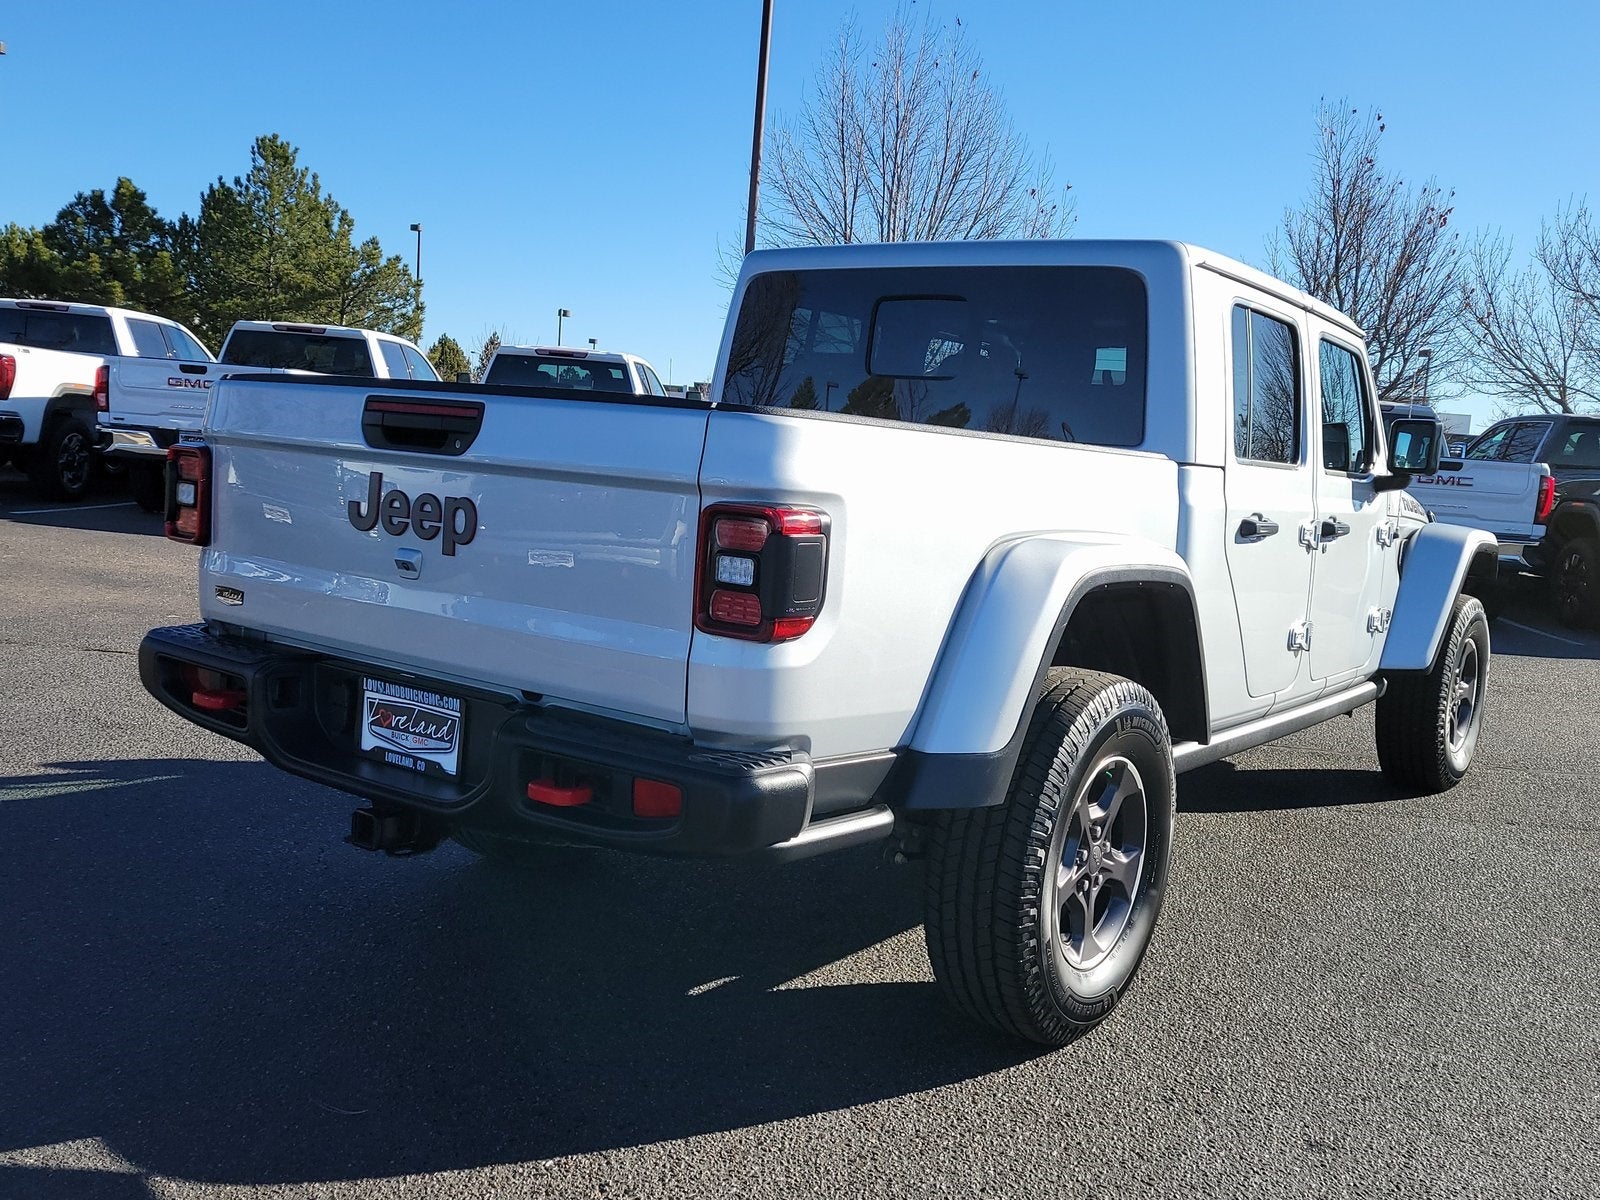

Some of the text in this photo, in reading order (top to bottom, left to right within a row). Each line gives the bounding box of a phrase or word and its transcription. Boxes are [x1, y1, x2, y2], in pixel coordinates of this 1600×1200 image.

[168, 377, 214, 388] GMC
[1416, 475, 1474, 486] GMC
[347, 471, 478, 556] Jeep
[363, 677, 461, 712] LOVELANDBUICKGMC.COM
[391, 730, 429, 747] BUICK GMC
